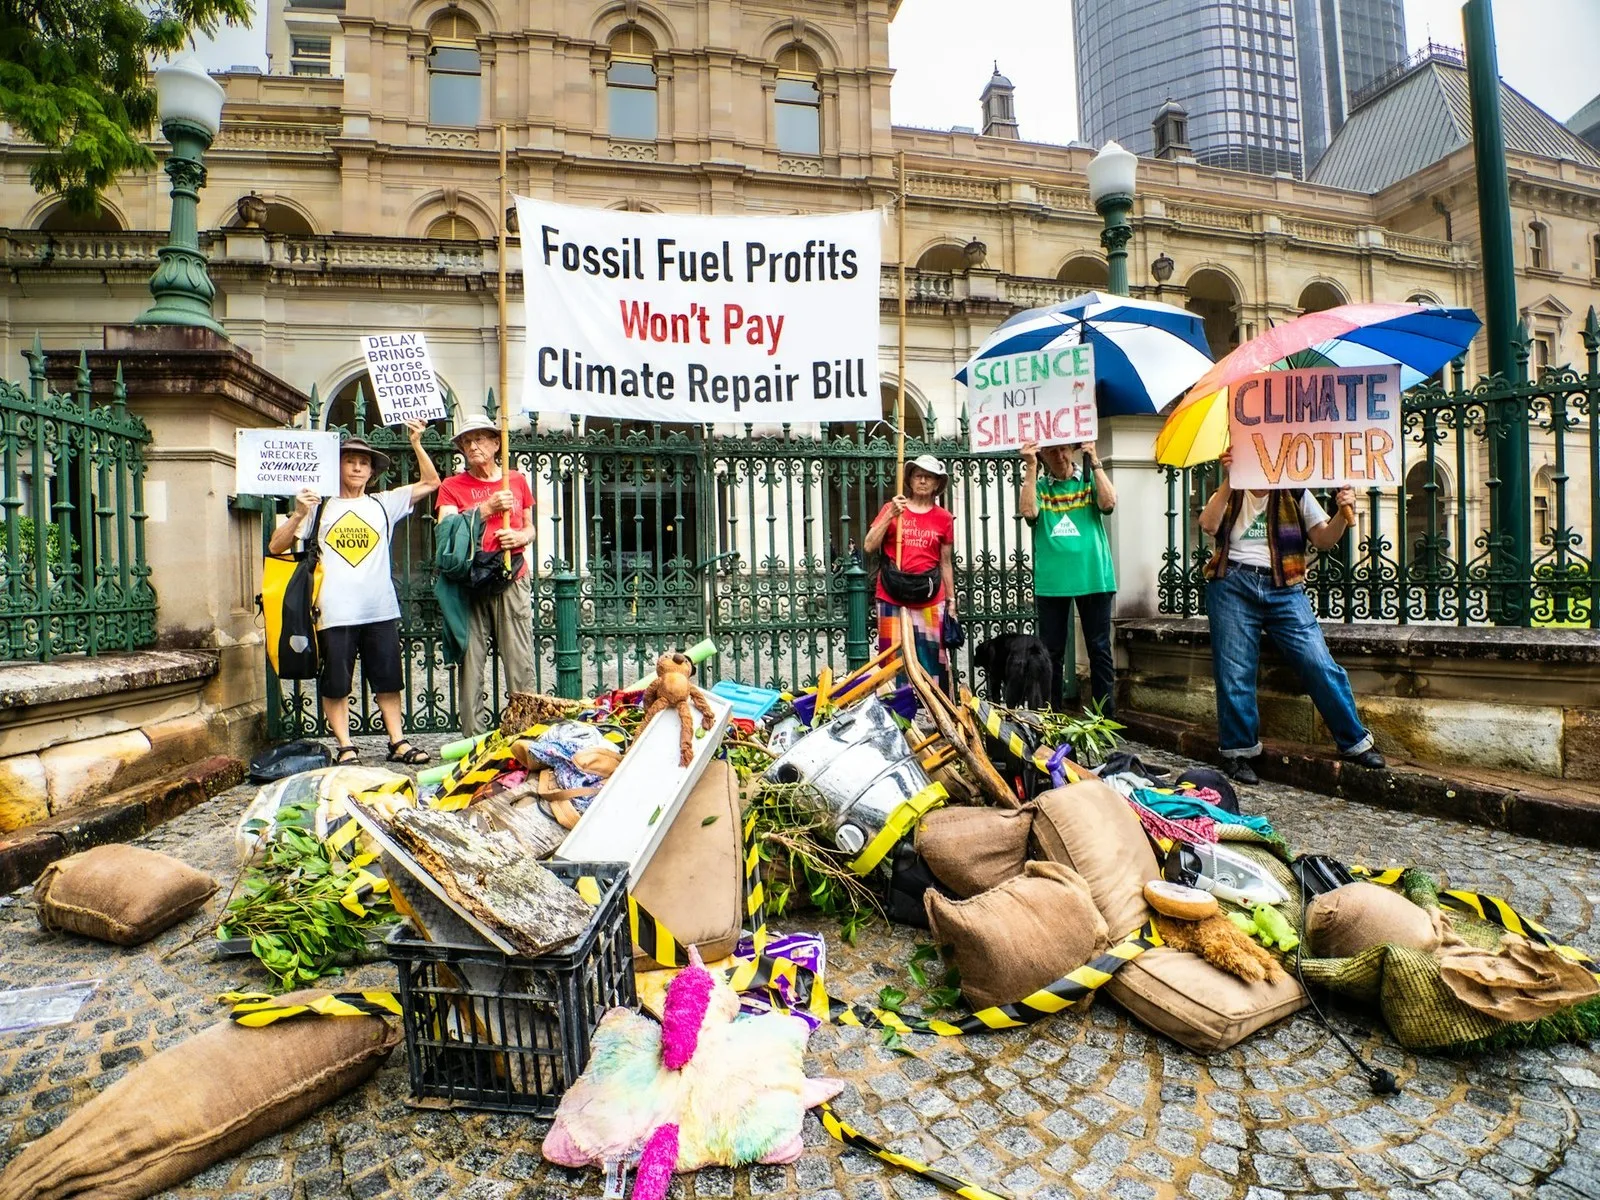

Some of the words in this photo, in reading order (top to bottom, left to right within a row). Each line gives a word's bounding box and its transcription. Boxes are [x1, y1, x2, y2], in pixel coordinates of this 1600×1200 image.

[541, 225, 644, 280] Fossil
[657, 238, 733, 282] Fuel
[746, 240, 858, 283] Profits
[619, 300, 710, 344] Won't
[723, 303, 784, 355] Pay
[368, 334, 416, 348] DELAY
[368, 346, 425, 362] BRINGS
[376, 361, 423, 373] worse
[974, 346, 1090, 391] SCIENCE
[375, 370, 431, 384] FLOODS
[538, 346, 674, 400] Climate
[688, 363, 799, 412] Repair
[812, 358, 867, 400] Bill
[378, 382, 435, 398] STORMS
[1003, 386, 1042, 410] NOT
[392, 395, 428, 409] HEAT
[1234, 373, 1390, 426] CLIMATE
[384, 407, 442, 423] DROUGHT
[976, 404, 1093, 447] SILENCE
[264, 440, 314, 450] CLIMATE
[260, 450, 318, 460] WRECKERS
[1251, 427, 1395, 484] VOTER
[260, 461, 320, 472] SCHMOOZE
[257, 473, 321, 483] GOVERNMENT
[1248, 529, 1268, 537] GREE
[336, 539, 369, 549] NOW
